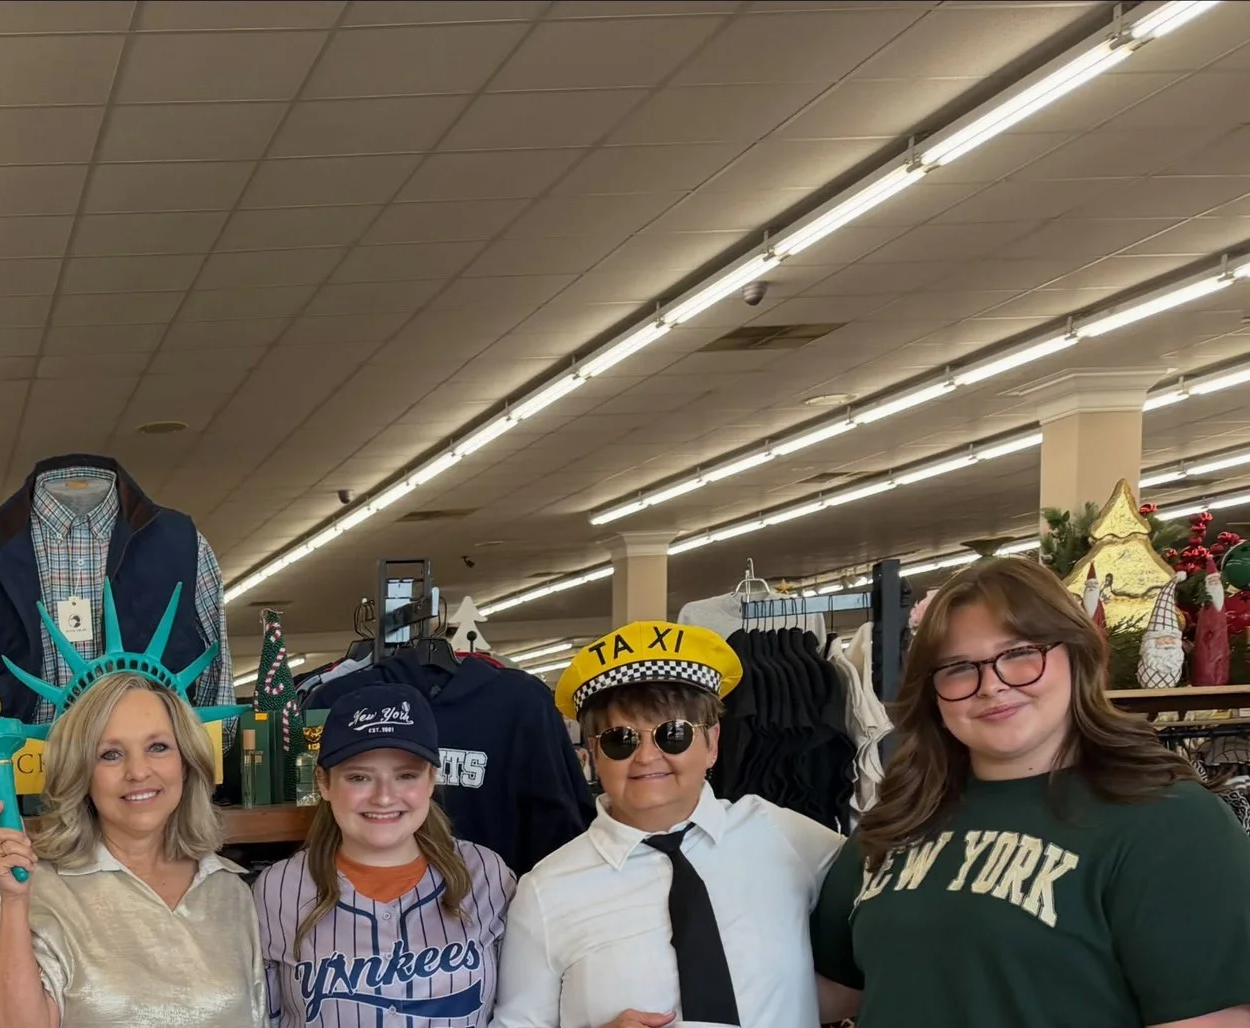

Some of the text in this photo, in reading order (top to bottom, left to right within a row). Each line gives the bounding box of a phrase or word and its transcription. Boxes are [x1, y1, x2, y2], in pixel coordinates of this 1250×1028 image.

[588, 626, 685, 666] TAXI
[348, 701, 411, 727] New York
[945, 830, 1080, 928] YORK
